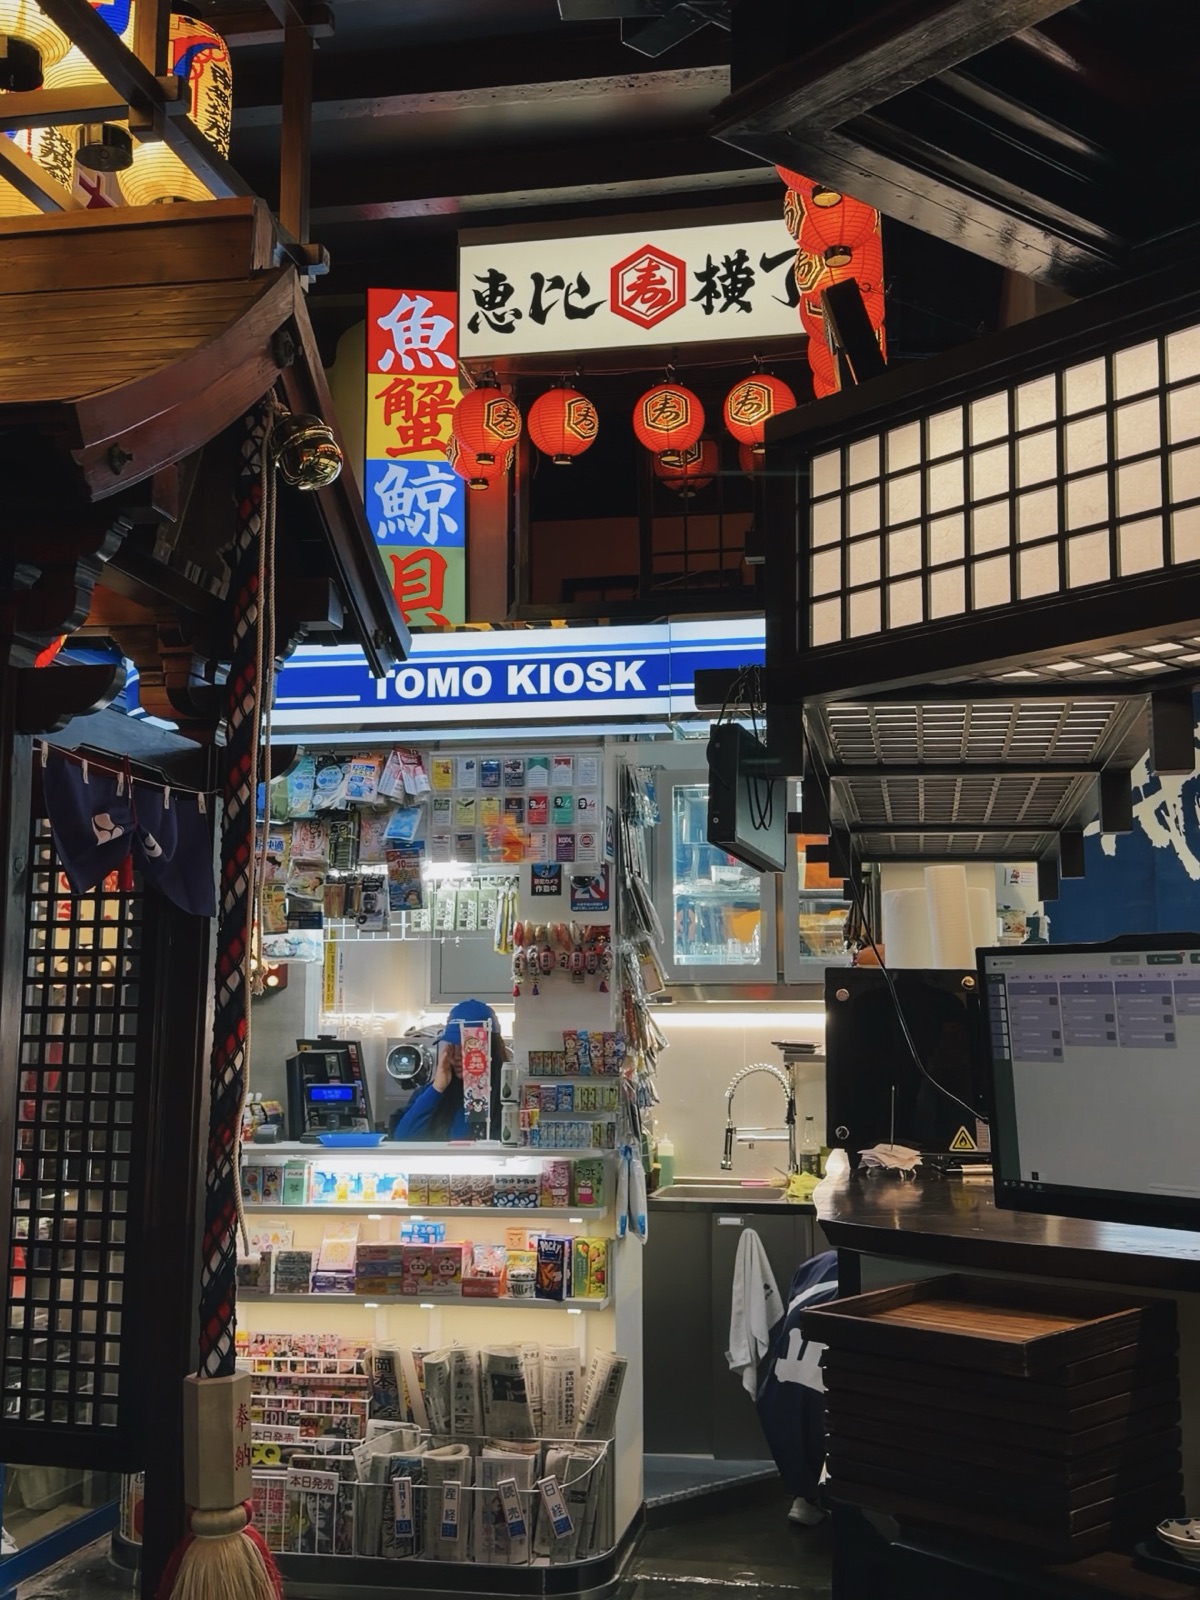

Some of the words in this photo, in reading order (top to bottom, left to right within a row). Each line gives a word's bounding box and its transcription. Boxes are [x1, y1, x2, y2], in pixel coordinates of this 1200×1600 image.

[368, 665, 492, 700] TOMO
[506, 659, 647, 697] KIOSK
[252, 1430, 295, 1443] 本日発売
[289, 1475, 334, 1490] 本日発売
[502, 1485, 520, 1521] 読売
[544, 1484, 564, 1517] 日経
